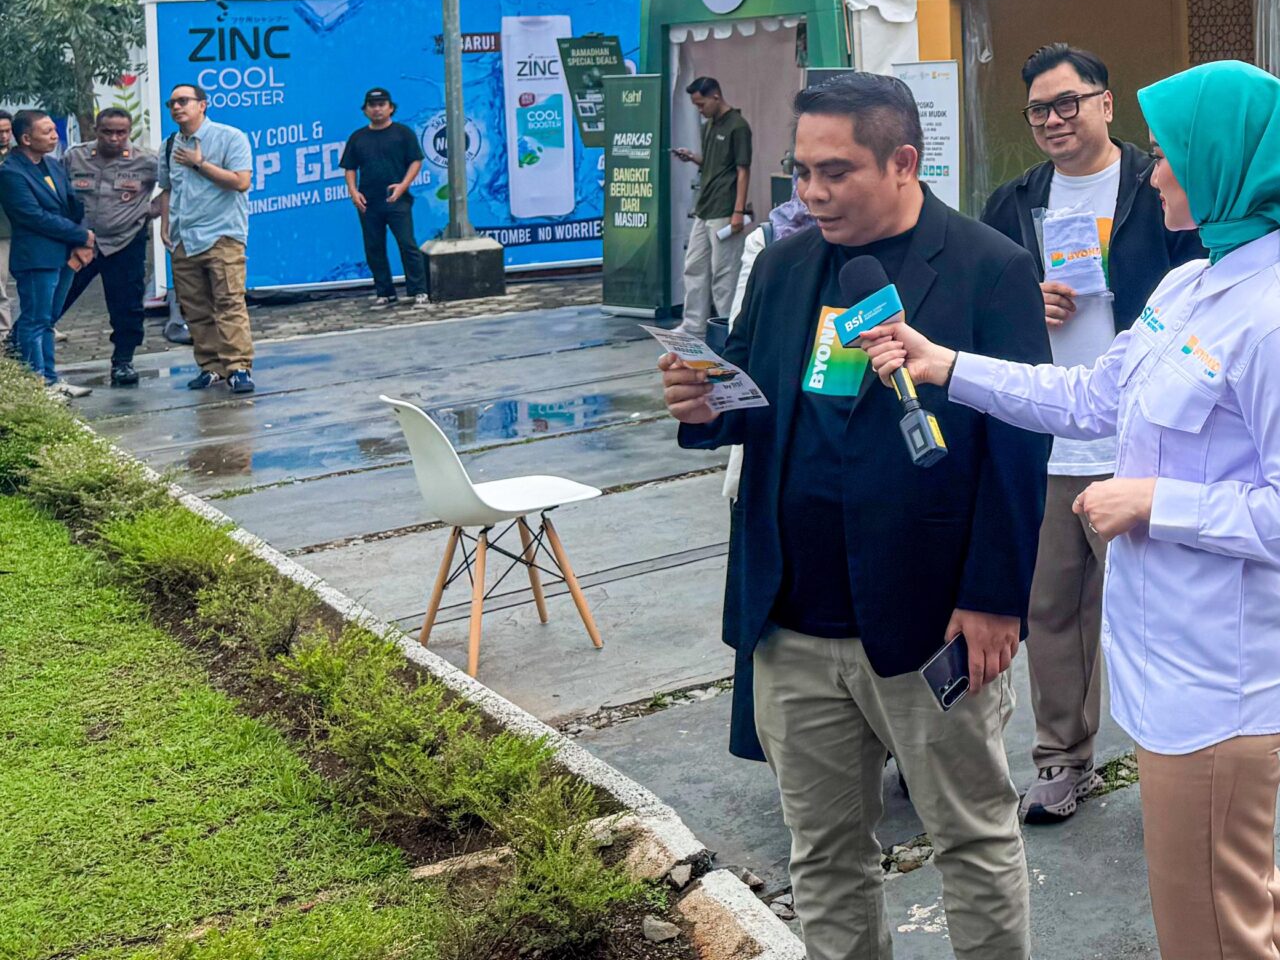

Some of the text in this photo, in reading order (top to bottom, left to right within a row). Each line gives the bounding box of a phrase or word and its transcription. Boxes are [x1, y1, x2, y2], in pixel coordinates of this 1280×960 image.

[188, 26, 290, 63] ZINC
[460, 35, 495, 52] ARU!
[571, 48, 610, 57] RAMADHAN
[517, 59, 559, 78] ZINC
[567, 56, 618, 66] SPECIAL DEALS
[197, 66, 285, 90] COOL
[622, 90, 642, 103] Kahf
[527, 110, 561, 122] COOL
[266, 123, 307, 147] COOL
[312, 121, 323, 139] &
[613, 133, 652, 146] MARKAS
[613, 167, 649, 182] BANGKIT
[610, 183, 652, 197] BERJUANG
[621, 199, 640, 212] DARI
[614, 213, 647, 227] MASJID!
[538, 227, 552, 241] NO
[555, 220, 604, 240] WORRIE
[1140, 306, 1154, 322] SI
[844, 313, 863, 332] BSI
